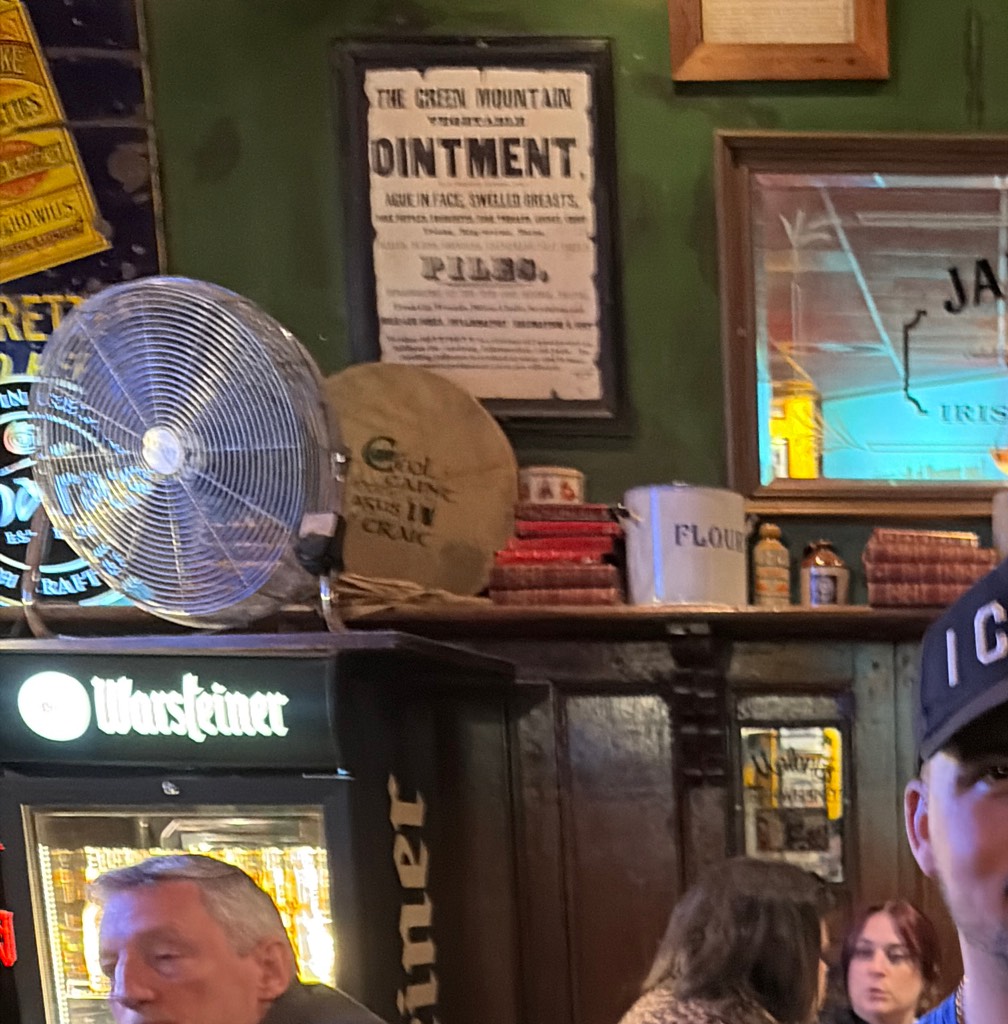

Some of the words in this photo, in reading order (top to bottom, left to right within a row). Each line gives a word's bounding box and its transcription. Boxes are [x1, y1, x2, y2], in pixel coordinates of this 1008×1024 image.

[377, 88, 405, 109] THE
[414, 88, 466, 109] GREEN
[475, 88, 572, 109] MOUNTAIN
[91, 672, 289, 743] Warsteiner
